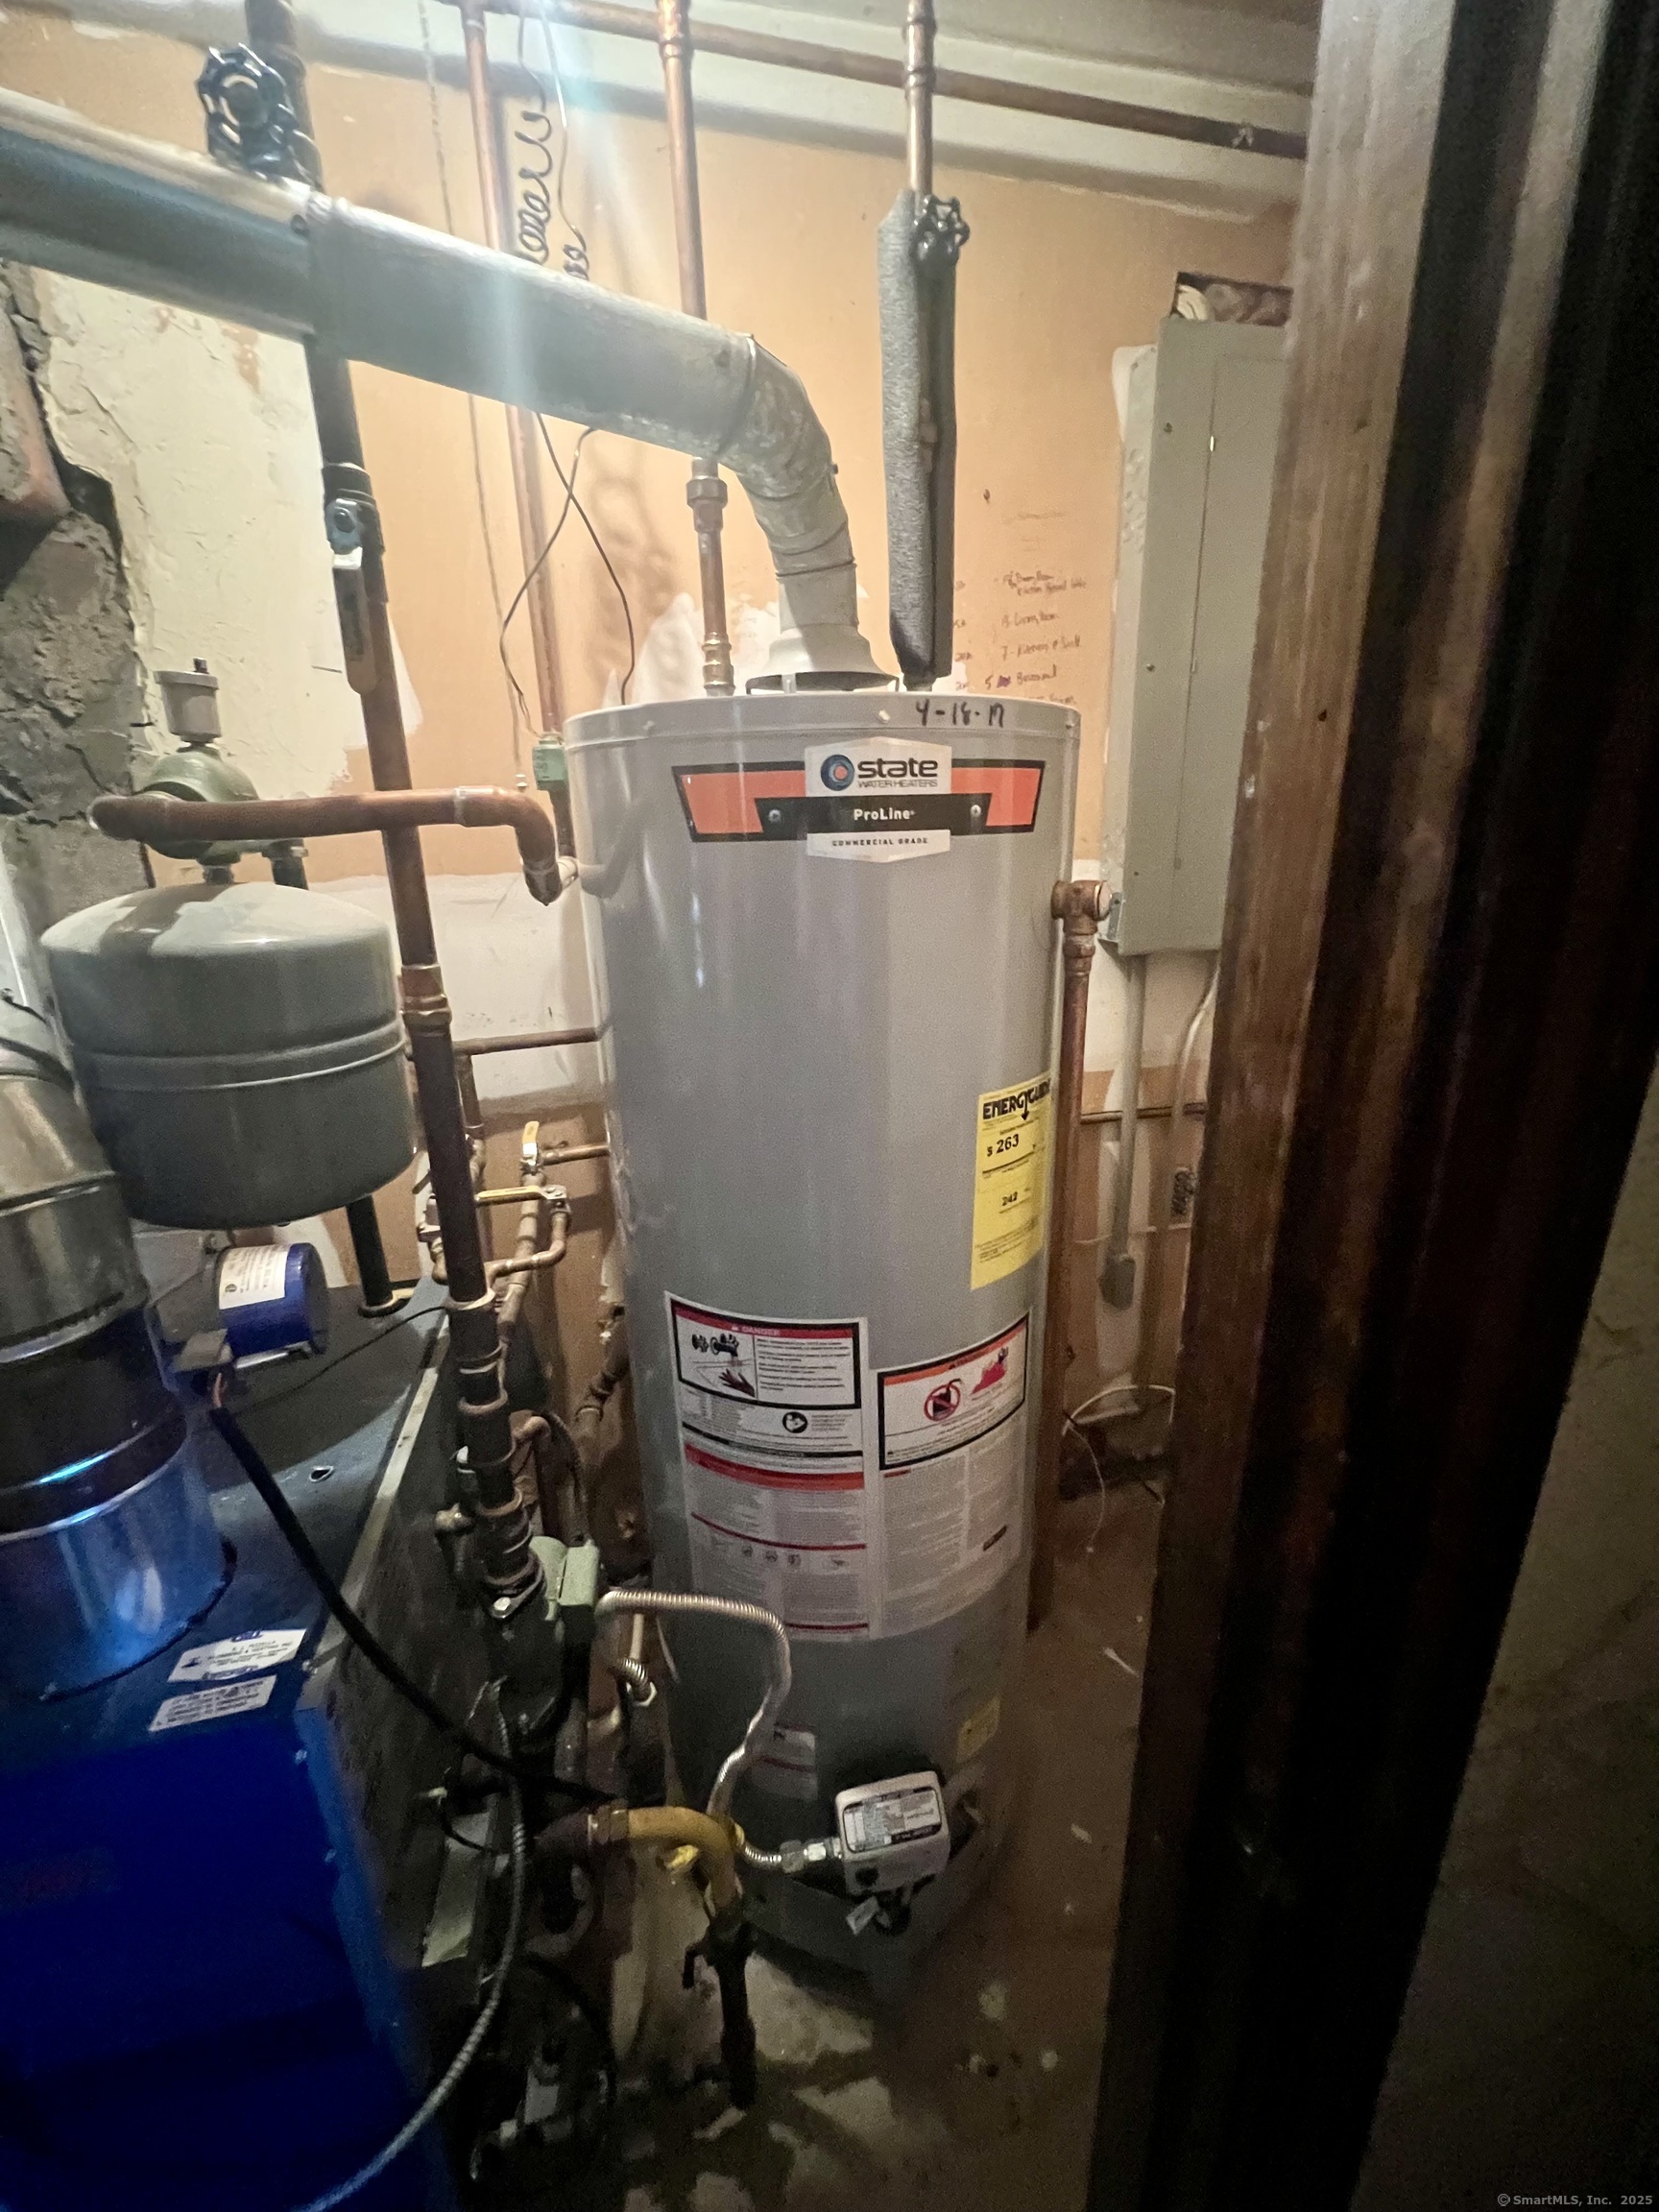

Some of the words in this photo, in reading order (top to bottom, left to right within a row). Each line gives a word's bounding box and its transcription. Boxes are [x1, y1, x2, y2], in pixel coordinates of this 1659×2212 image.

[857, 757, 938, 779] state
[857, 779, 893, 788] WATER
[893, 779, 938, 788] HEATERS
[997, 1133, 1020, 1154] 263
[741, 1325, 781, 1336] DANGER
